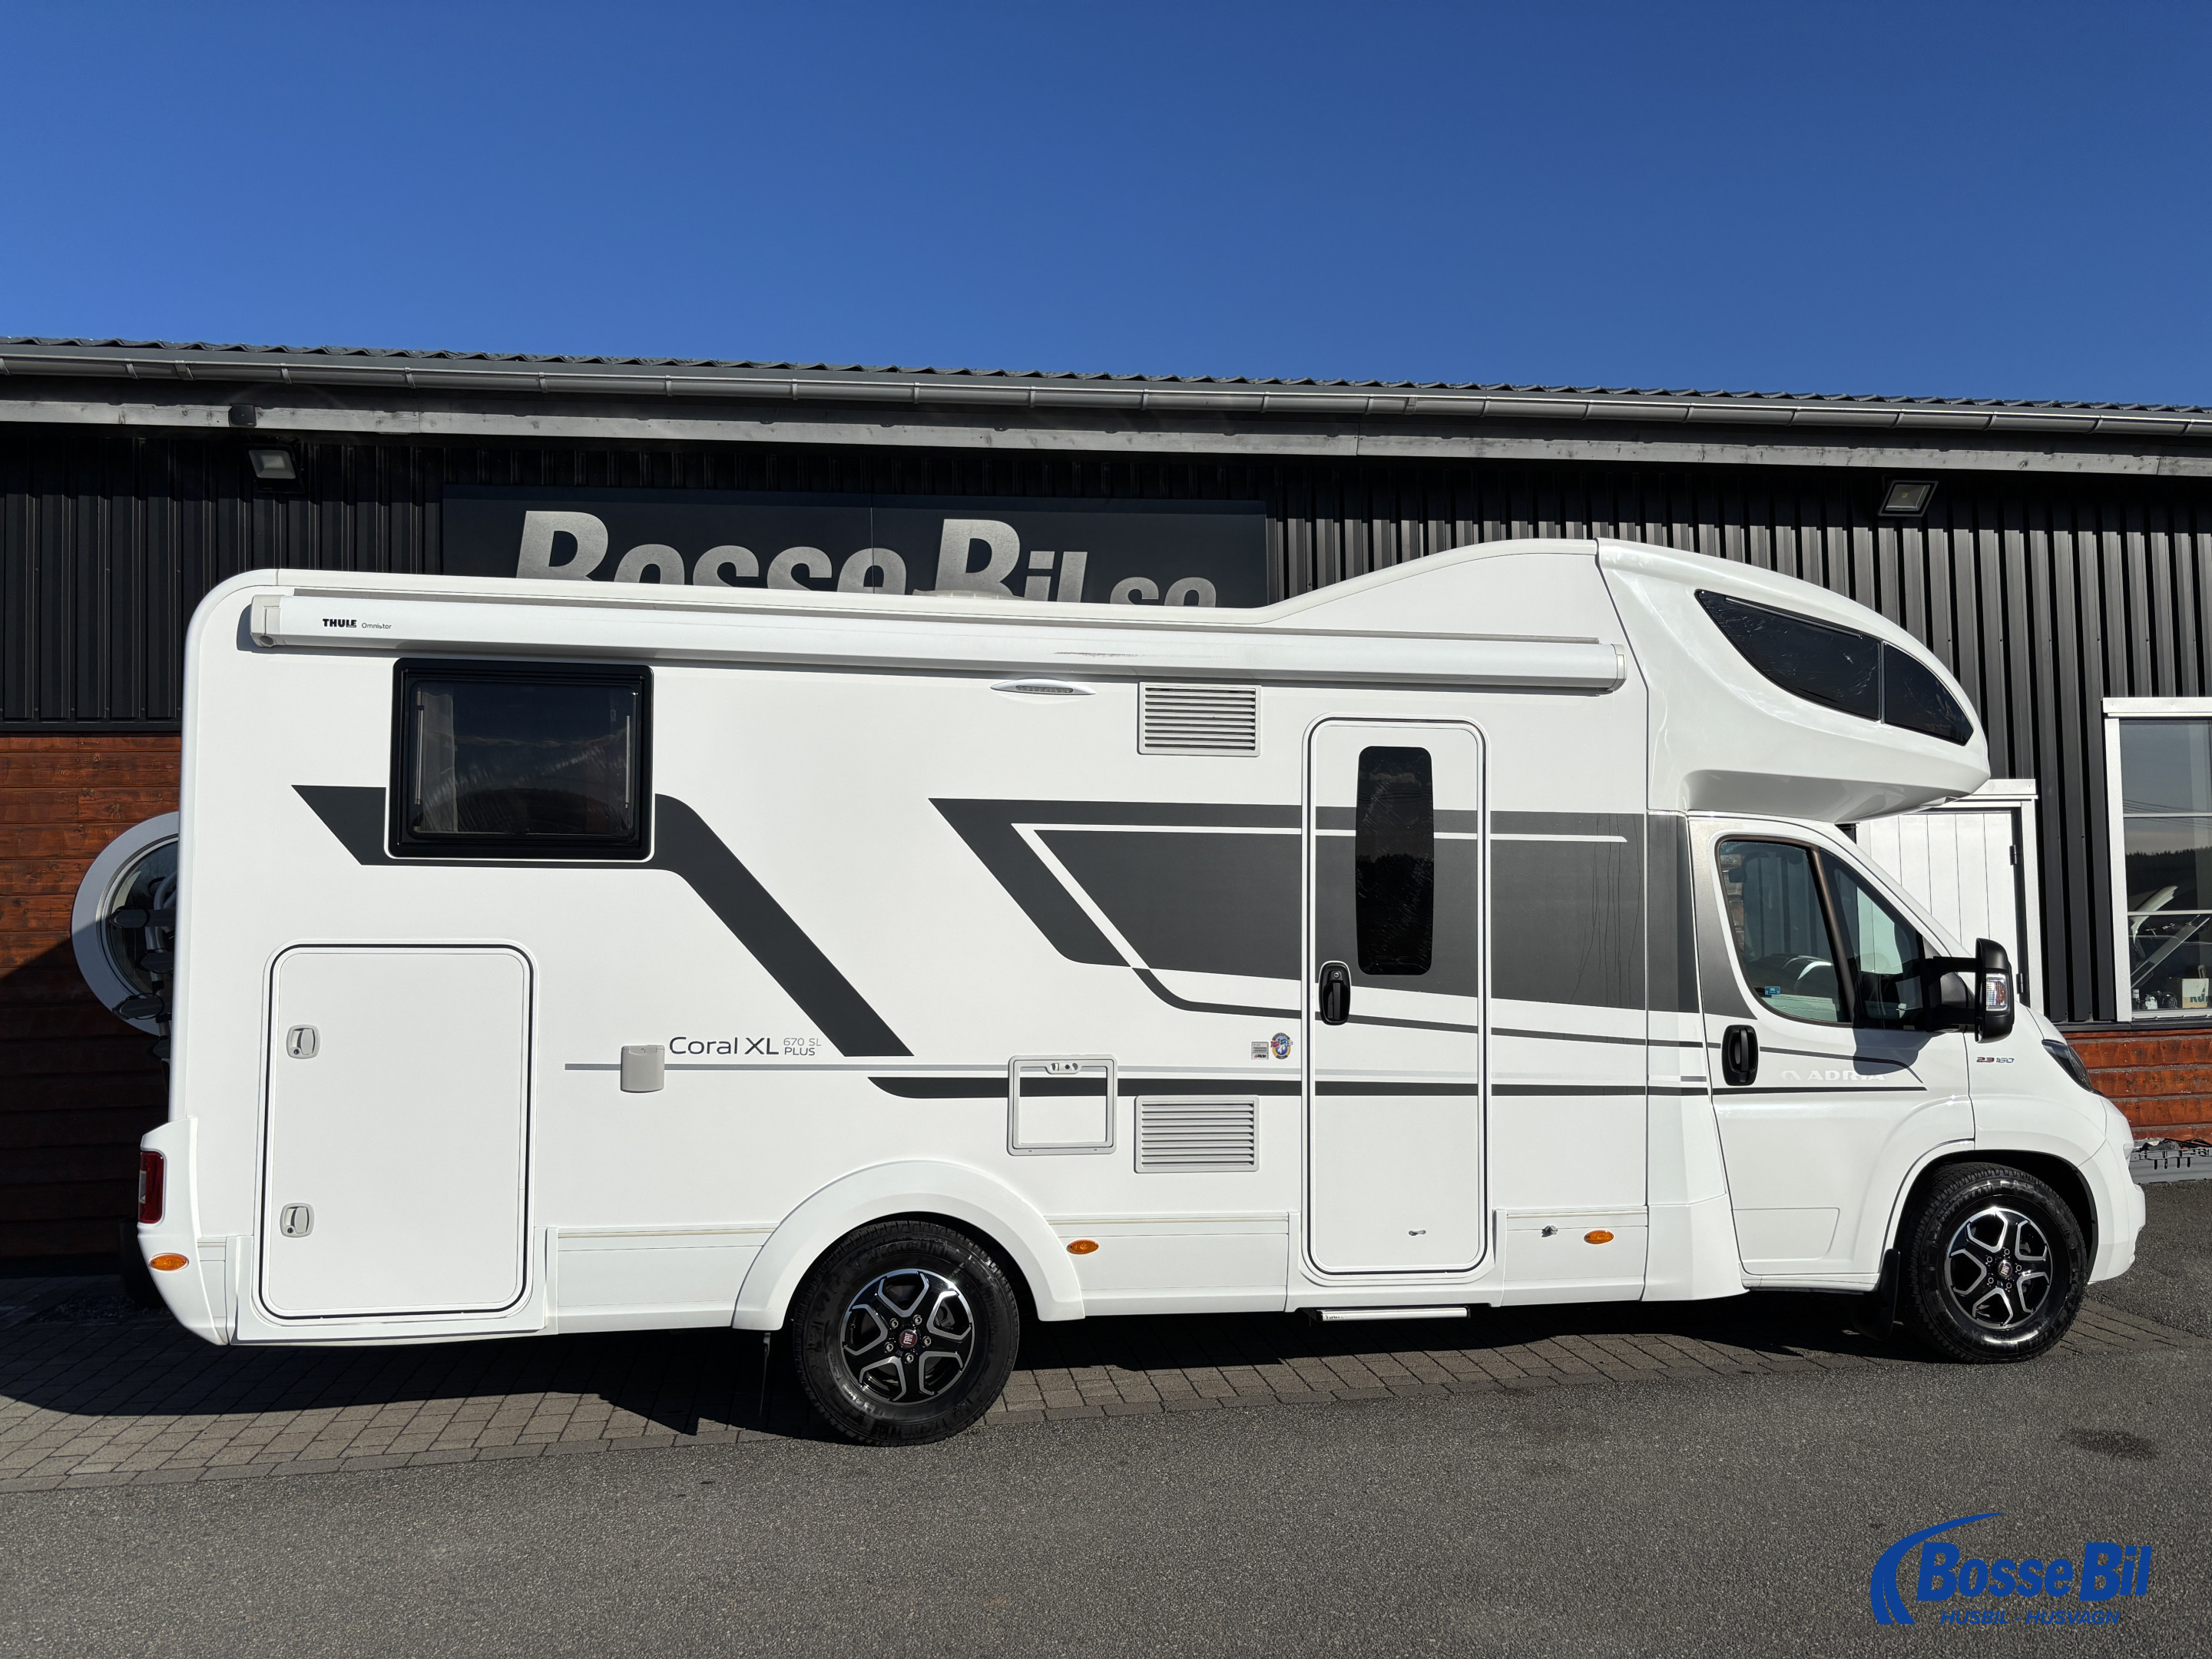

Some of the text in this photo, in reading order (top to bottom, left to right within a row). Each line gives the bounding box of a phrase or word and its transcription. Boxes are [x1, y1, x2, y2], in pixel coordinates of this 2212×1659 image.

[322, 618, 357, 628] THULE
[669, 1036, 780, 1055] Coral XL
[783, 1038, 822, 1047] 670 SL
[784, 1047, 816, 1056] PLUS
[903, 1332, 914, 1345] FIAT
